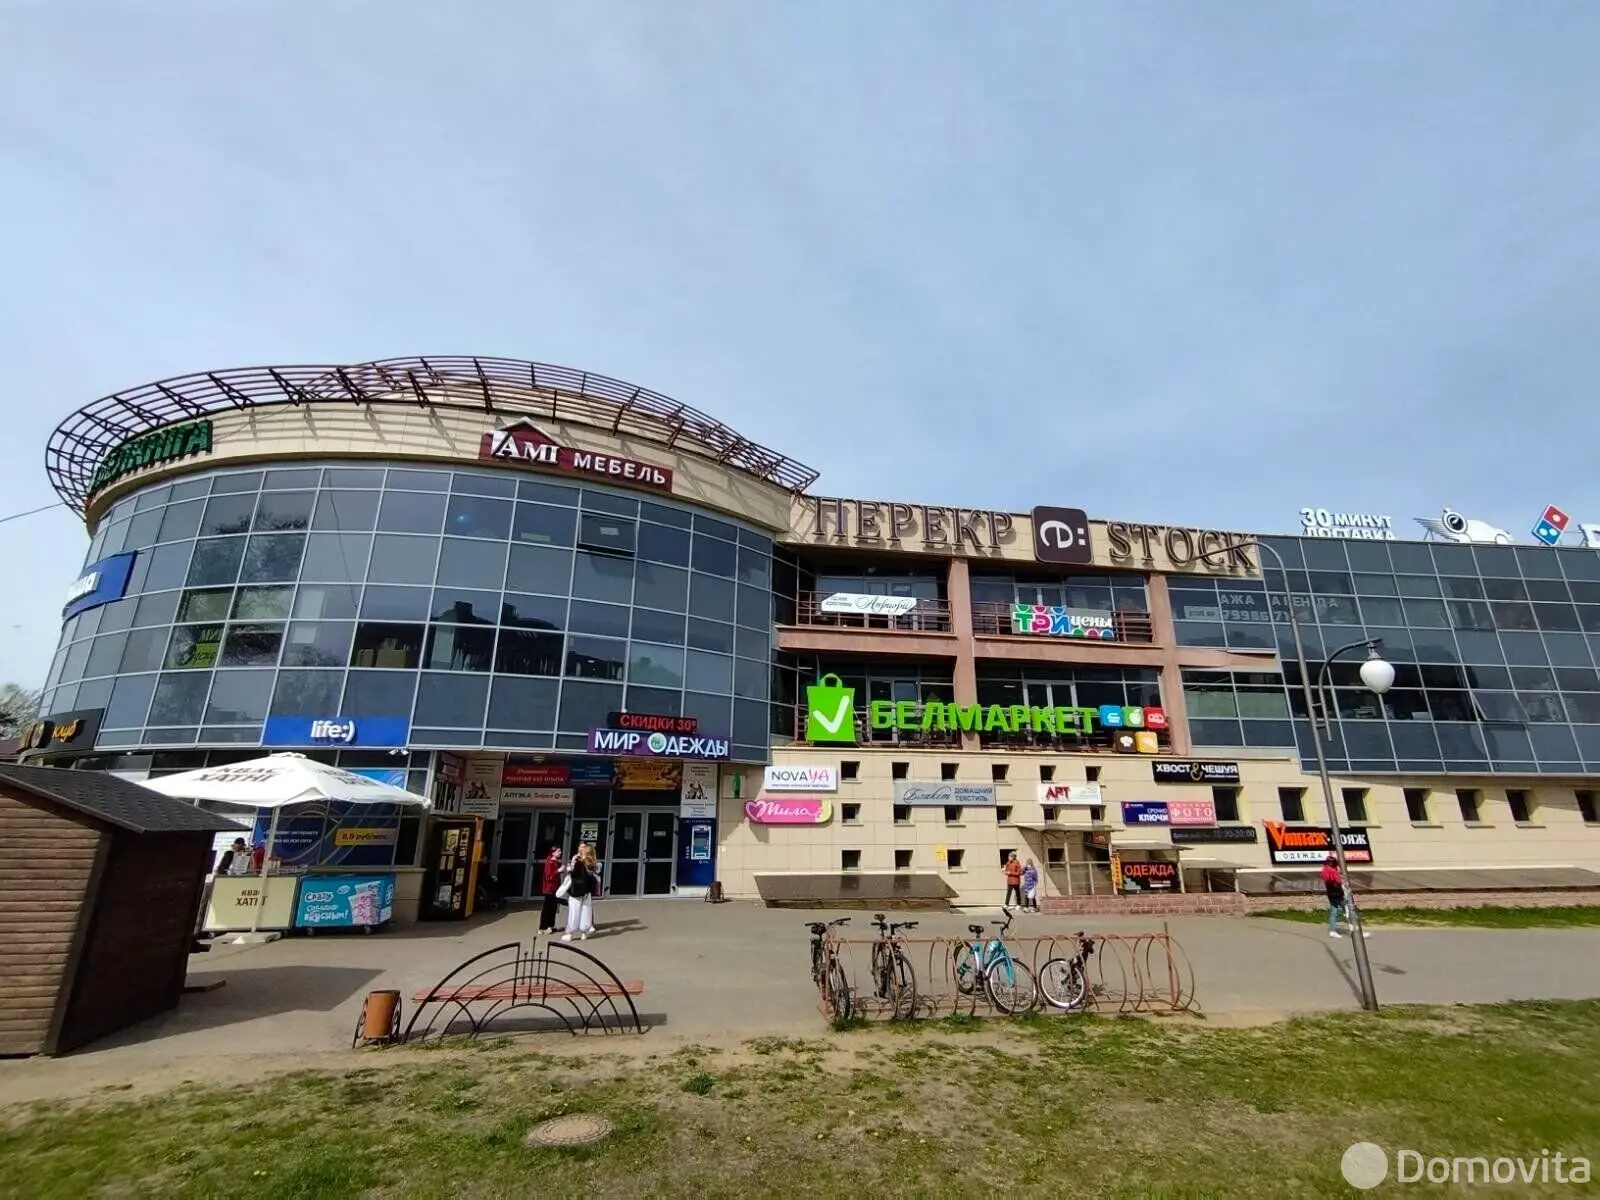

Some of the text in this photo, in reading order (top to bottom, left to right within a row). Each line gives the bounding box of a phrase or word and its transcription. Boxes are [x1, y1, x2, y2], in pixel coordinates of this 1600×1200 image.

[574, 452, 666, 485] МЕБЕЛЬ
[1300, 507, 1392, 529] 30 МИНУТ
[812, 495, 1013, 548] ПЕРЕКР
[1107, 521, 1256, 570] STOCK
[1070, 615, 1113, 629] цены
[620, 714, 674, 731] СКИДКИ
[871, 700, 1099, 734] БЕЛМАРКЕТ
[595, 731, 729, 758] МИР ОДЕЖДЫ
[1156, 764, 1191, 773] ХВОСТ
[1201, 764, 1238, 774] ЧЕШУЯ
[1138, 813, 1168, 822] КЛЮЧИ
[1171, 807, 1213, 818] ФОТО
[1125, 864, 1175, 878] ОДЕЖДА
